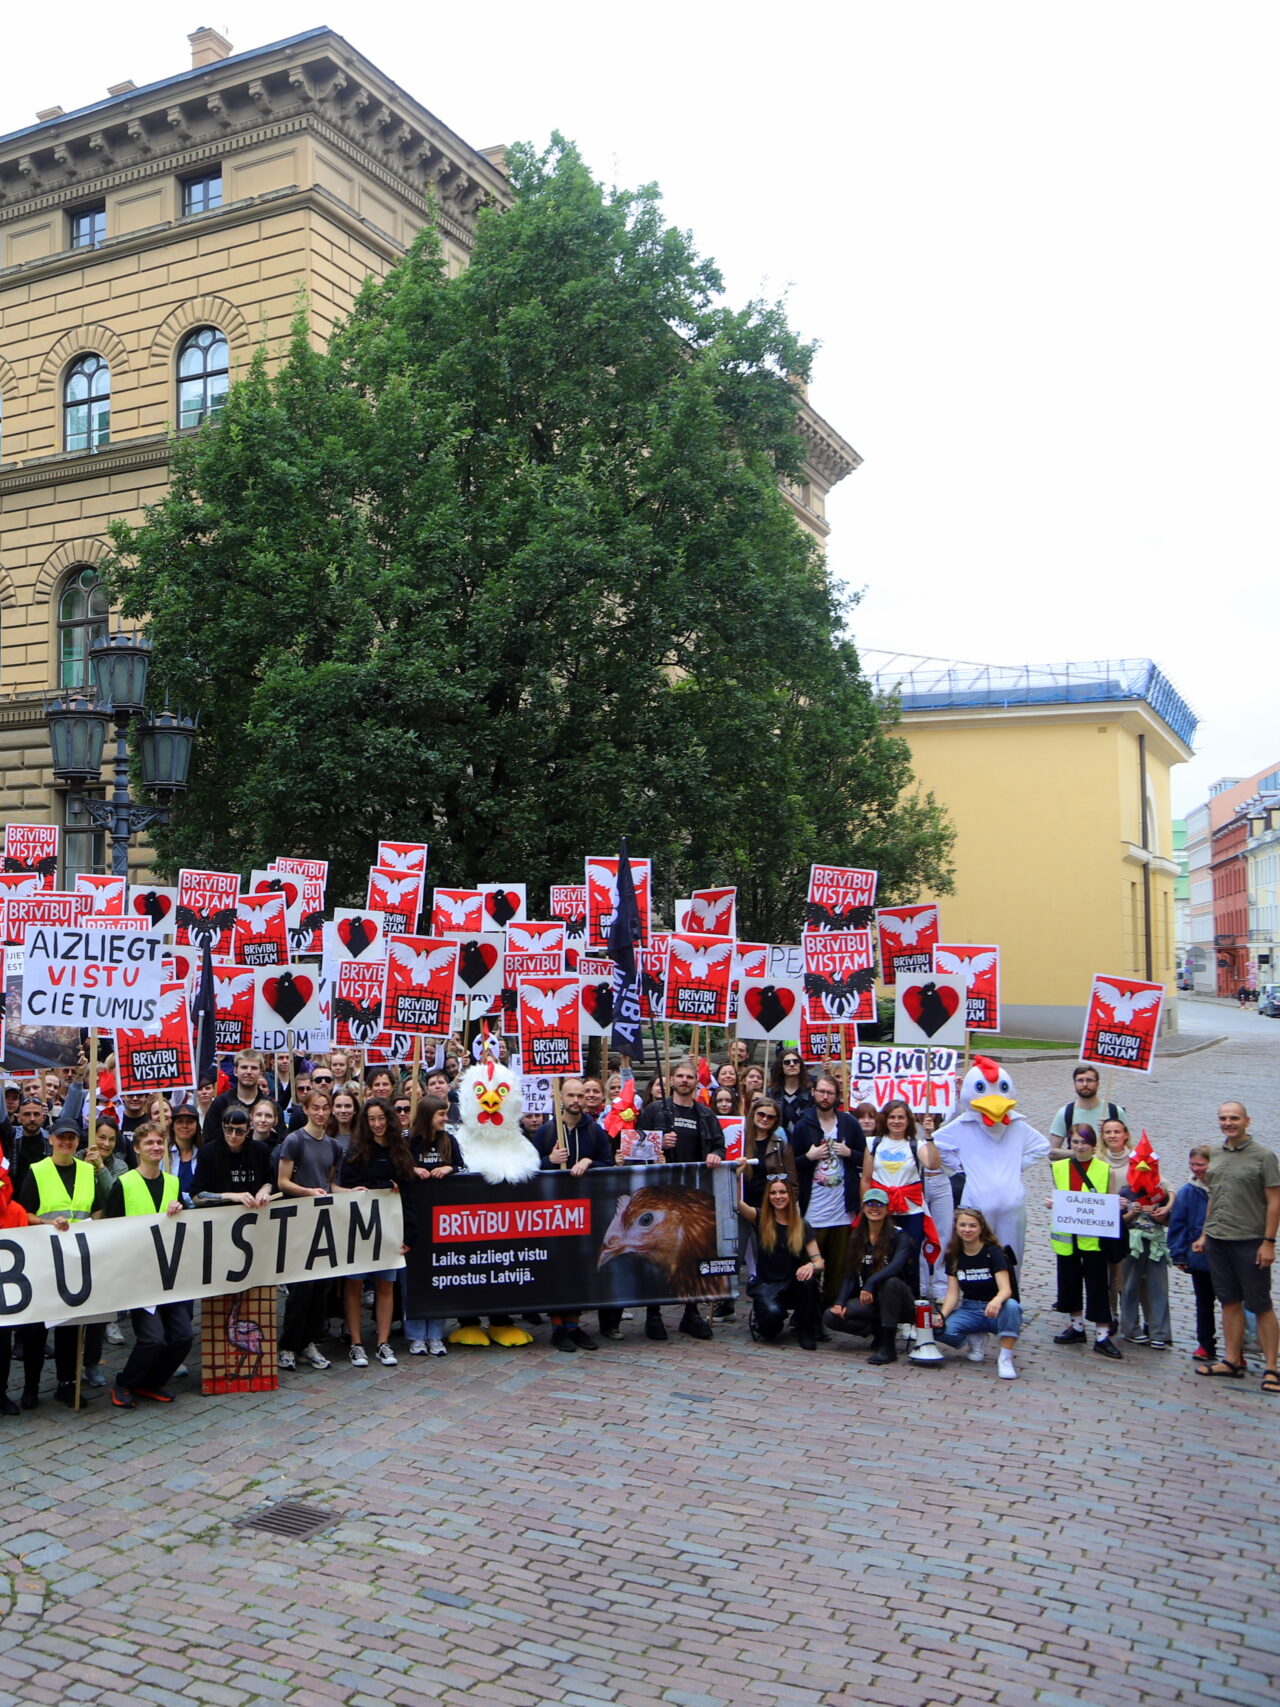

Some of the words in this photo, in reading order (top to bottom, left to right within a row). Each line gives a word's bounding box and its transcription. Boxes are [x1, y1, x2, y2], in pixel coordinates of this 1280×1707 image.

[8, 828, 55, 842] BRĪVĪBU
[8, 843, 53, 857] VISTĀM
[279, 861, 324, 877] BRĪVĪBU
[182, 874, 236, 893] BRĪVĪBU
[815, 870, 872, 890] BRĪVĪBU
[181, 890, 233, 909] VISTĀM
[553, 889, 586, 900] BRĪVĪB
[813, 887, 869, 905] VISTĀM
[9, 902, 69, 920] BRĪVĪBU
[553, 902, 585, 914] VISTĀ
[384, 914, 406, 923] ĪVĪBU
[384, 924, 404, 933] STĀM
[30, 930, 160, 963] AIZLIEGT
[244, 943, 277, 954] BRĪVĪBU
[806, 934, 867, 953] BRĪVĪBU
[245, 954, 278, 965] VISTĀM
[506, 956, 559, 970] BRĪVĪBU
[808, 953, 867, 971] VISTĀM
[894, 954, 929, 966] BRĪVĪBU
[342, 964, 385, 980] BRĪVĪB
[581, 962, 614, 975] BRĪVĪ
[48, 964, 140, 988] VISTU
[340, 982, 382, 998] VISTĀ
[678, 989, 716, 1002] BRĪVĪBU
[28, 990, 158, 1021] CIETUMUS
[398, 997, 438, 1011] BRĪVĪBU
[678, 1001, 715, 1014] VISTĀM
[398, 1011, 437, 1025] VISTĀM
[216, 1021, 242, 1032] ĪVĪBU
[216, 1032, 240, 1044] STĀM
[533, 1039, 568, 1050] BRĪVĪBU
[1098, 1031, 1140, 1049] BRĪVĪBU
[133, 1050, 176, 1064] BRĪVĪBU
[534, 1052, 569, 1065] VISTĀM
[1097, 1043, 1137, 1060] VISTĀM
[134, 1065, 177, 1080] VISTĀM
[528, 1102, 546, 1111] FLY
[1066, 1195, 1105, 1205] GĀJIENS
[438, 1209, 509, 1237] BRĪVĪBU
[516, 1205, 584, 1232] VISTĀM!
[1057, 1216, 1114, 1227] DZĪVNIEKIEM
[150, 1197, 382, 1290] VISTĀM
[432, 1252, 466, 1266] Laiks
[470, 1250, 515, 1268] aizliegt
[518, 1248, 547, 1262] vistu
[432, 1272, 486, 1290] sprostus
[490, 1269, 535, 1285] Latvijā.
